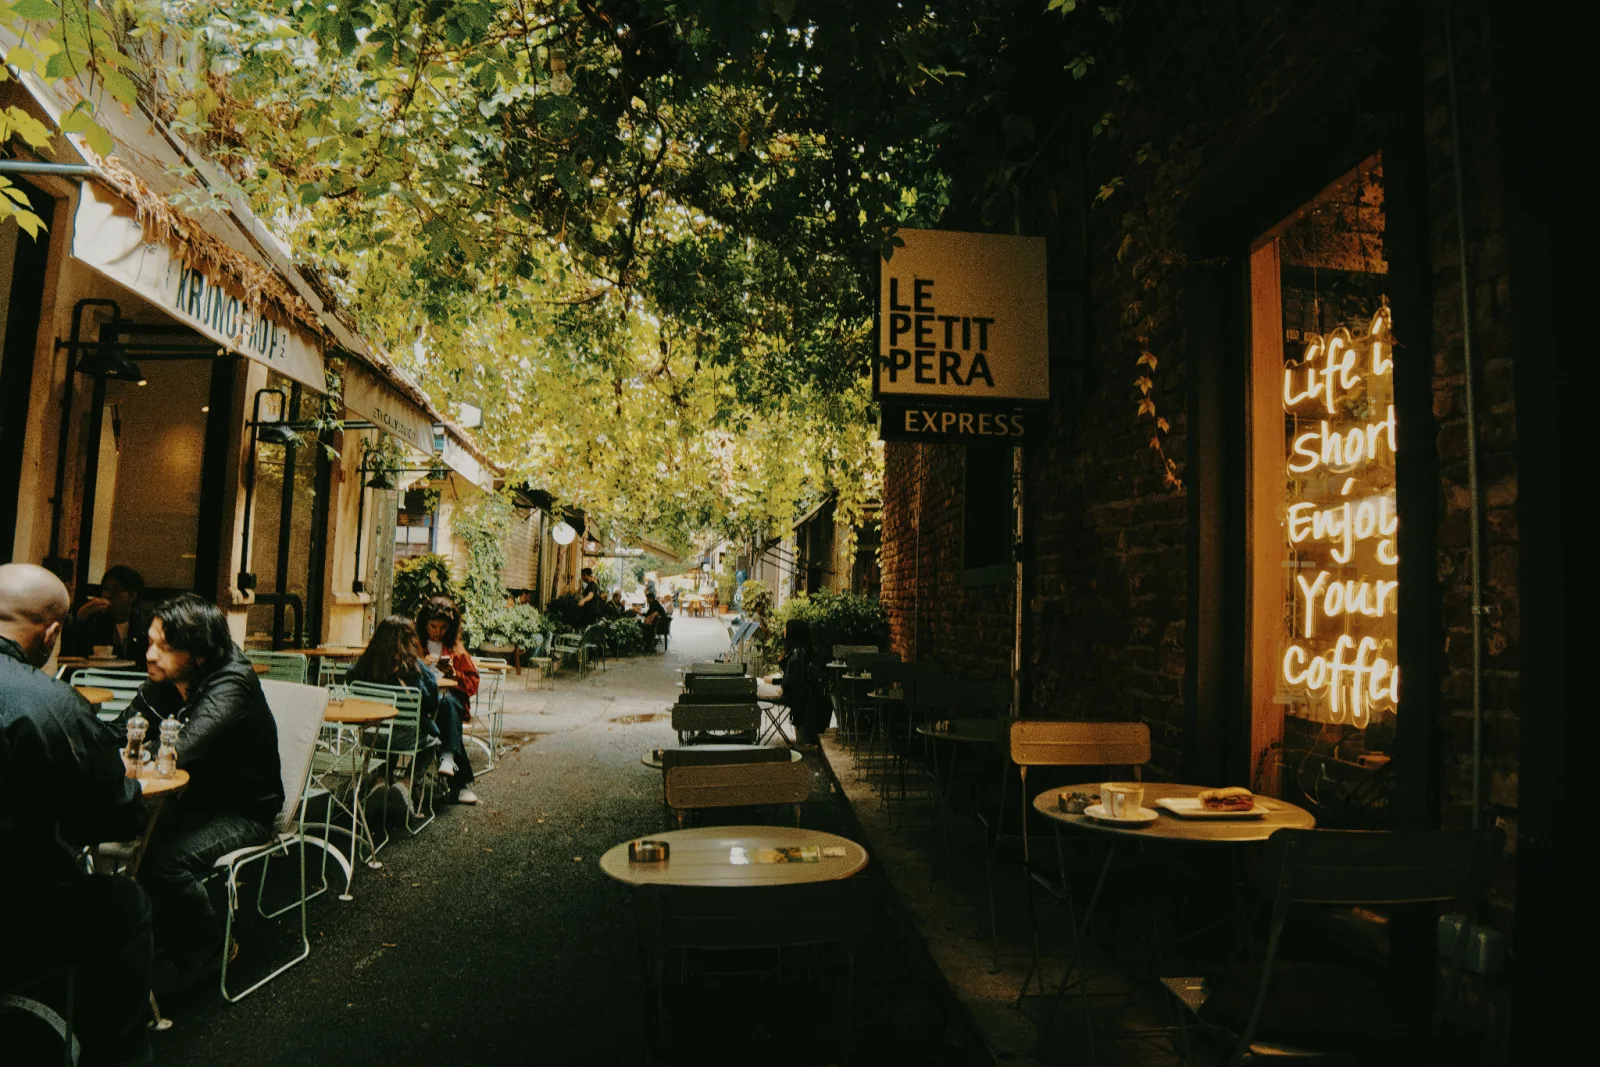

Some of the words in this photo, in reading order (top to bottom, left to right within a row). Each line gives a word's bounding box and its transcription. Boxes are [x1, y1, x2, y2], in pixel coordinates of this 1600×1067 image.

[889, 278, 935, 313] LE
[889, 314, 995, 351] PETIT
[889, 349, 995, 387] PERA
[1284, 338, 1361, 414] Life
[904, 409, 1025, 437] EXPRESS
[1297, 571, 1398, 638] Your
